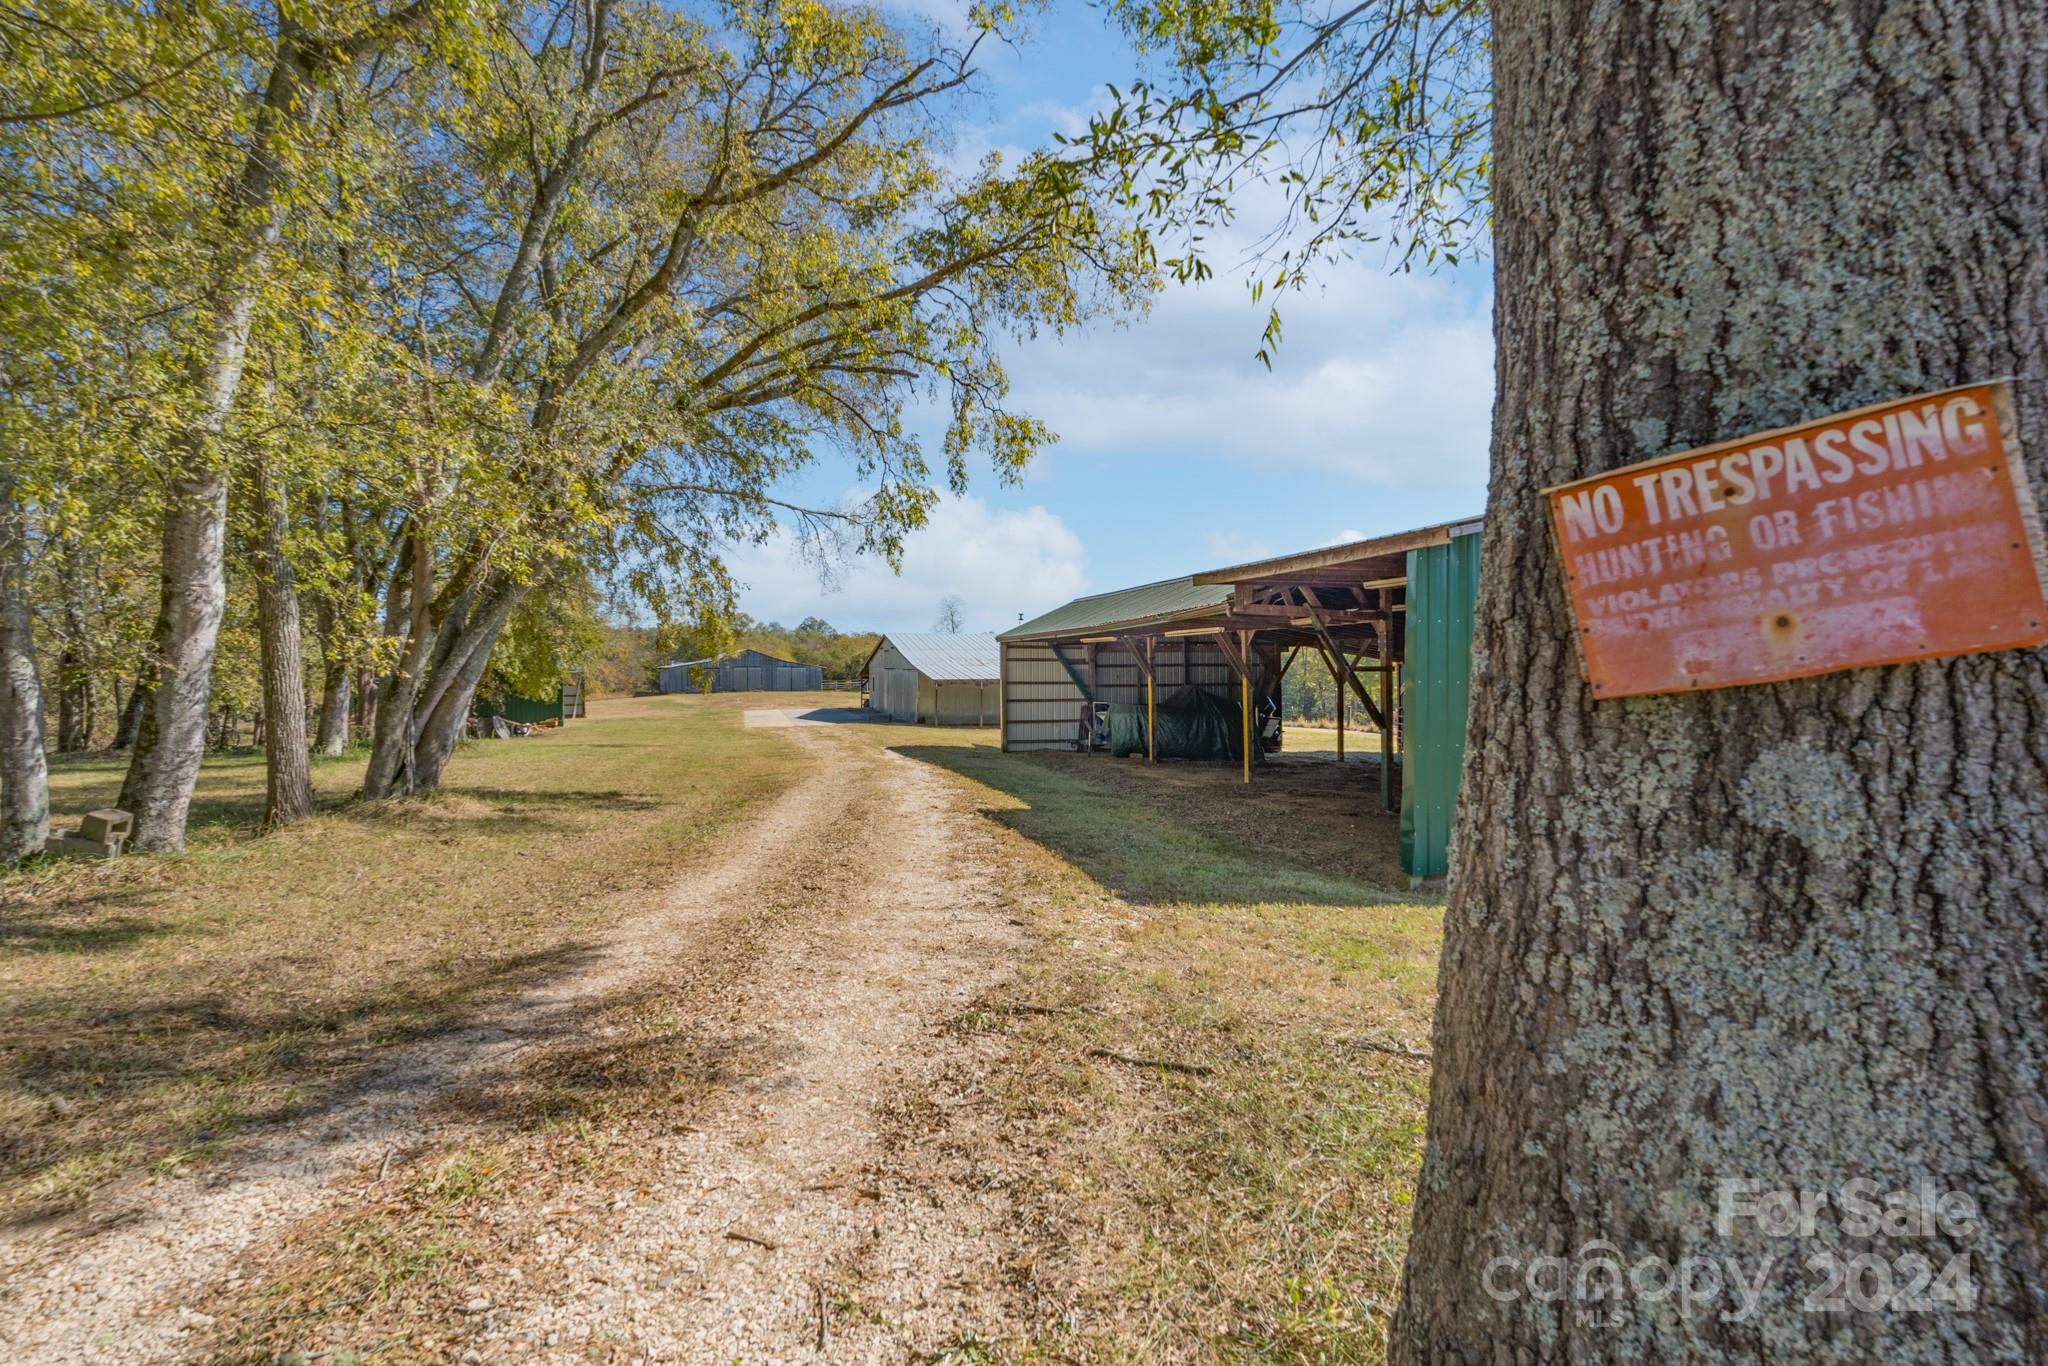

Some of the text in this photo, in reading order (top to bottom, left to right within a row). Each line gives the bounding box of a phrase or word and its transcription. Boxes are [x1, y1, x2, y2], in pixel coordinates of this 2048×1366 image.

[1560, 396, 1990, 542] NO TRESPASSING
[1573, 525, 1732, 590] HUNTING
[1748, 509, 1803, 551] OR
[1771, 522, 2010, 584] PROSECUT
